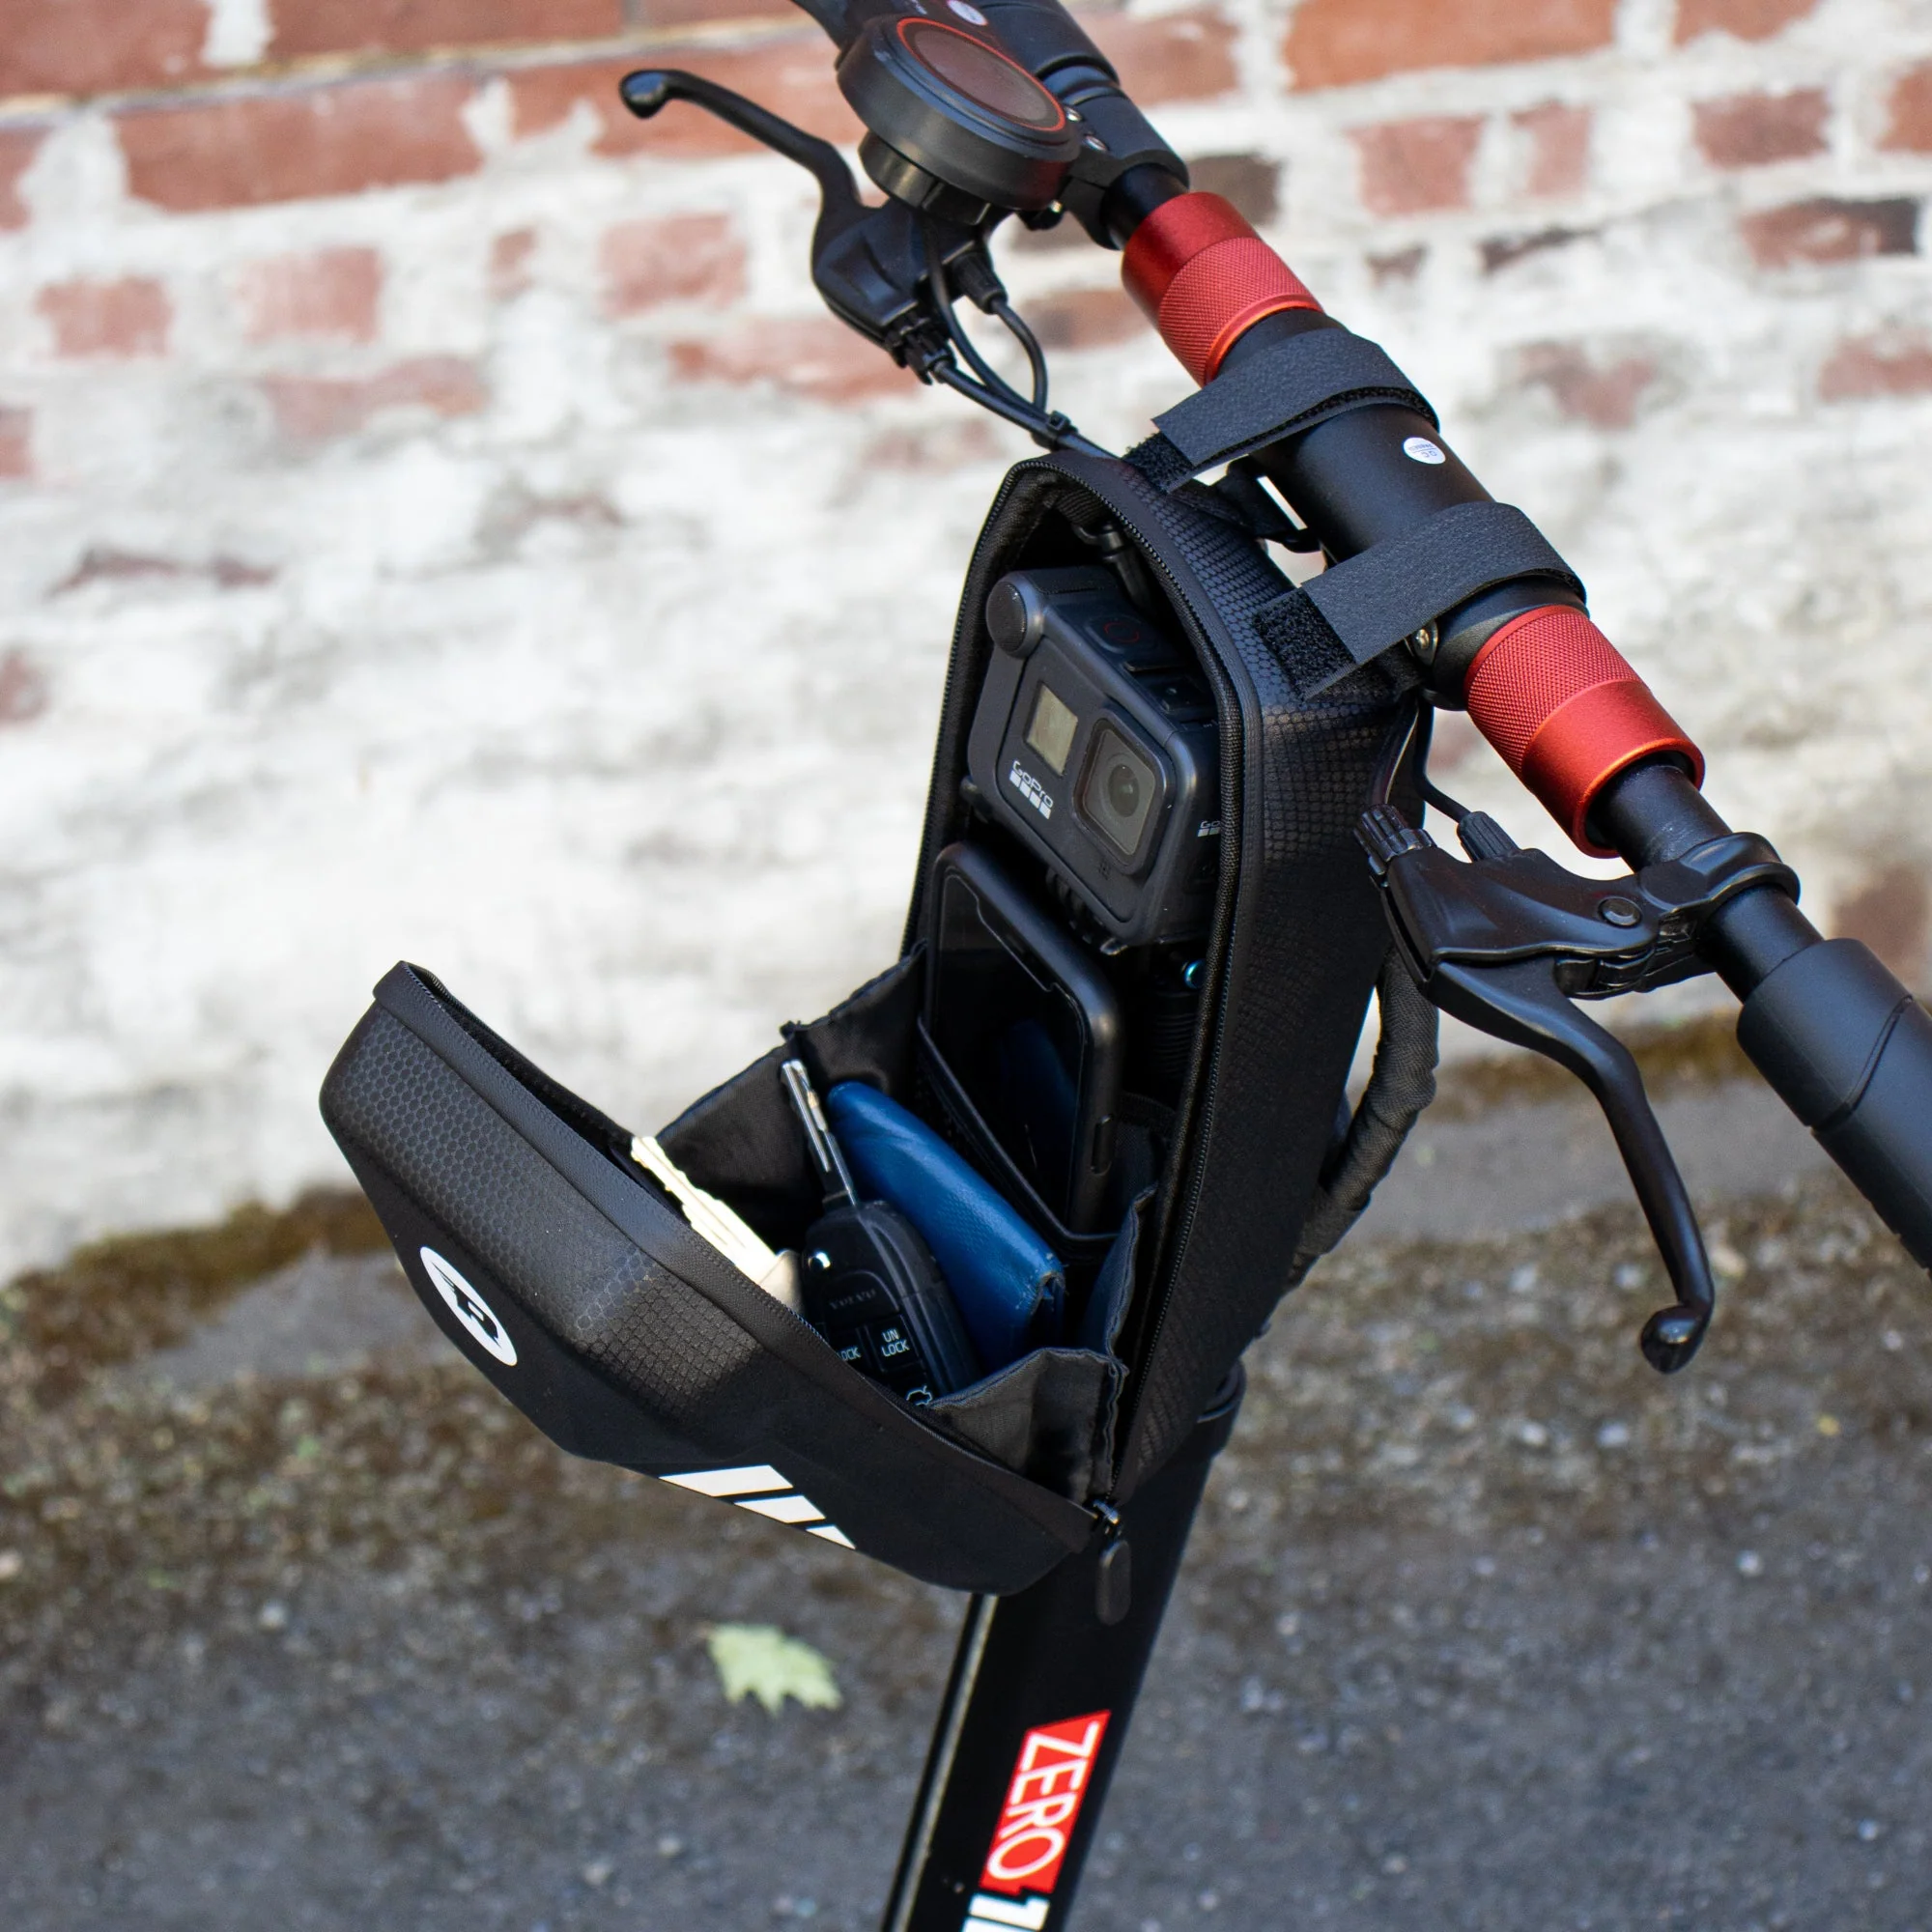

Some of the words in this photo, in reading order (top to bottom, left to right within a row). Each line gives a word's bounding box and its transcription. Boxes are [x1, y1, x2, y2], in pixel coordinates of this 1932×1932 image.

[1012, 760, 1054, 809] GoPro
[881, 1340, 910, 1357] LOCK
[882, 1328, 899, 1342] UN
[986, 1720, 1100, 1880] ZERO
[962, 1893, 1050, 1932] 1
